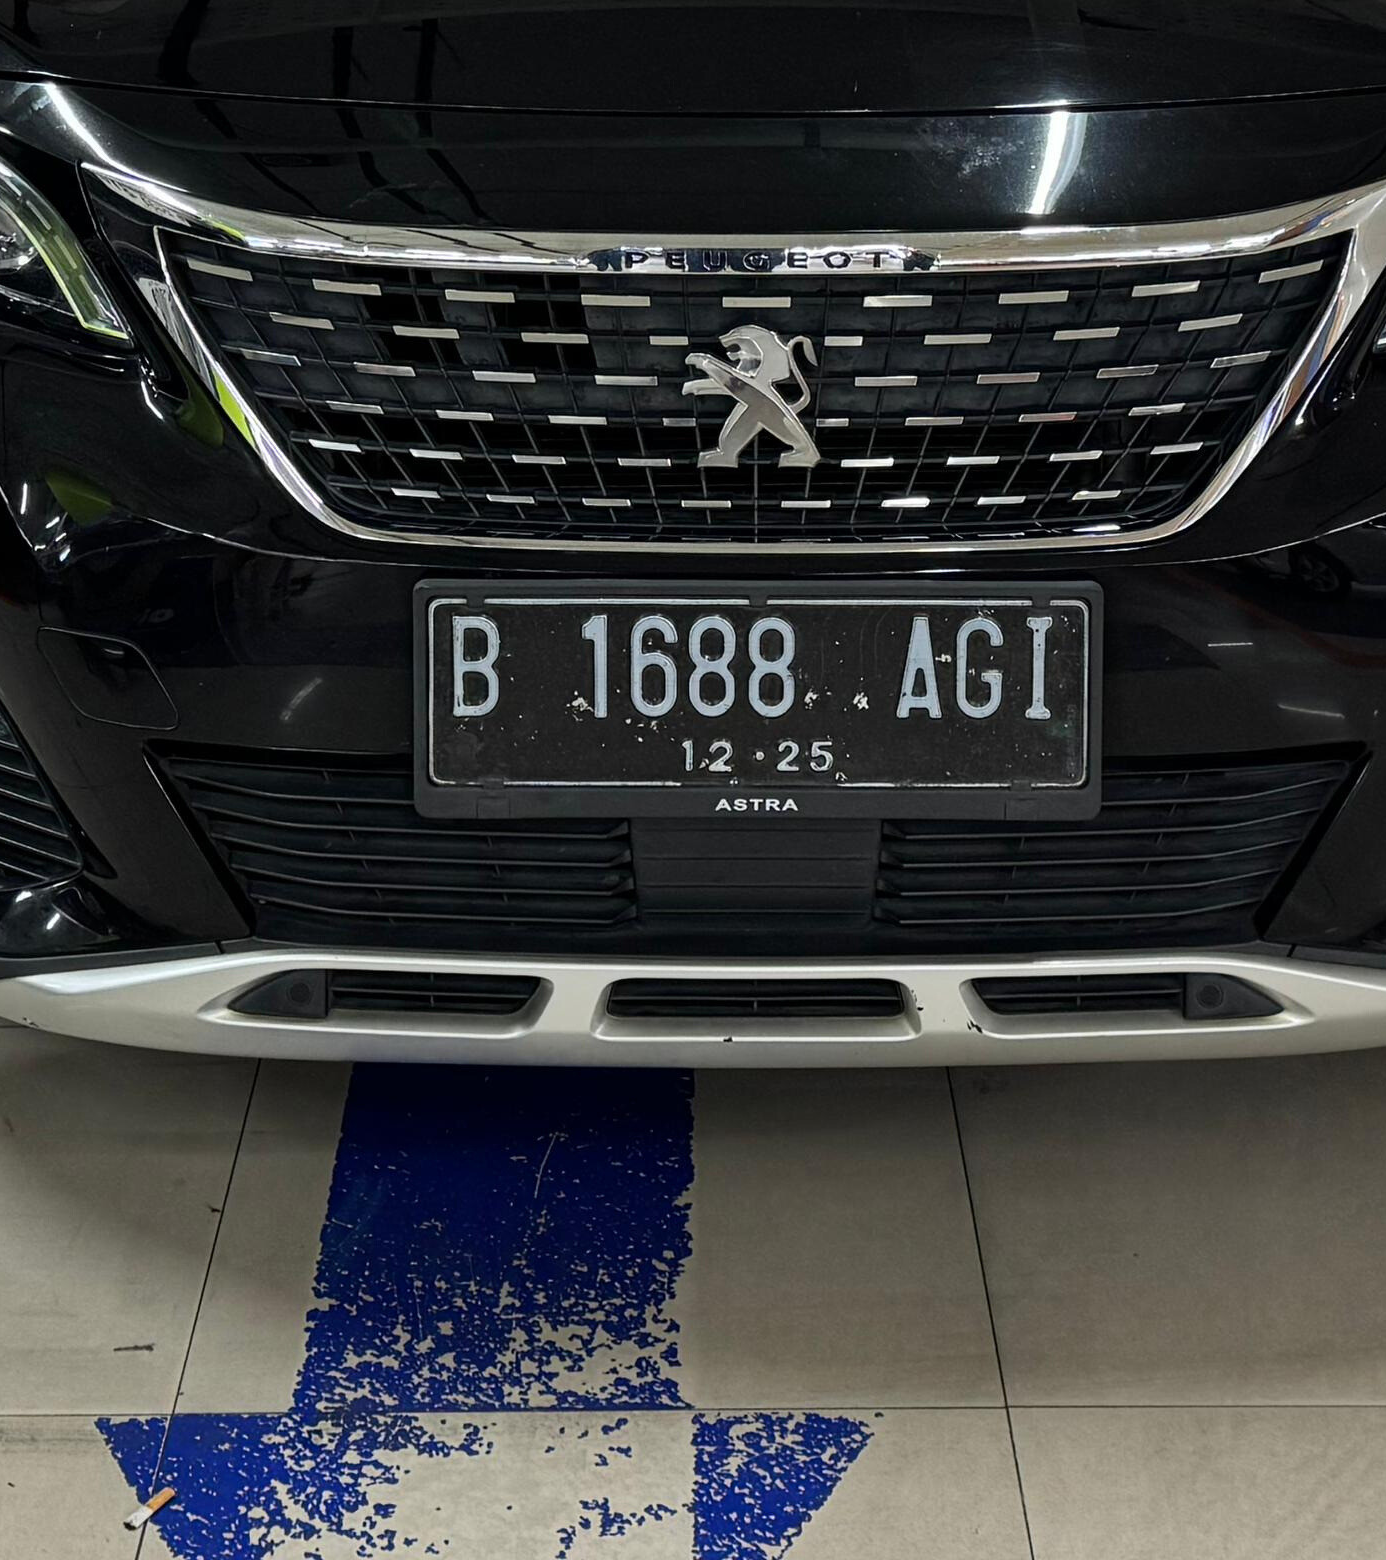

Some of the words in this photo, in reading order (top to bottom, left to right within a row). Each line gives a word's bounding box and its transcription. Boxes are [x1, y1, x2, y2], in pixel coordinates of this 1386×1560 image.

[624, 249, 891, 272] PEUGEOT
[453, 615, 500, 717] B
[581, 614, 796, 719] 1688
[896, 615, 1053, 720] AGI
[714, 797, 800, 813] ASTRA
